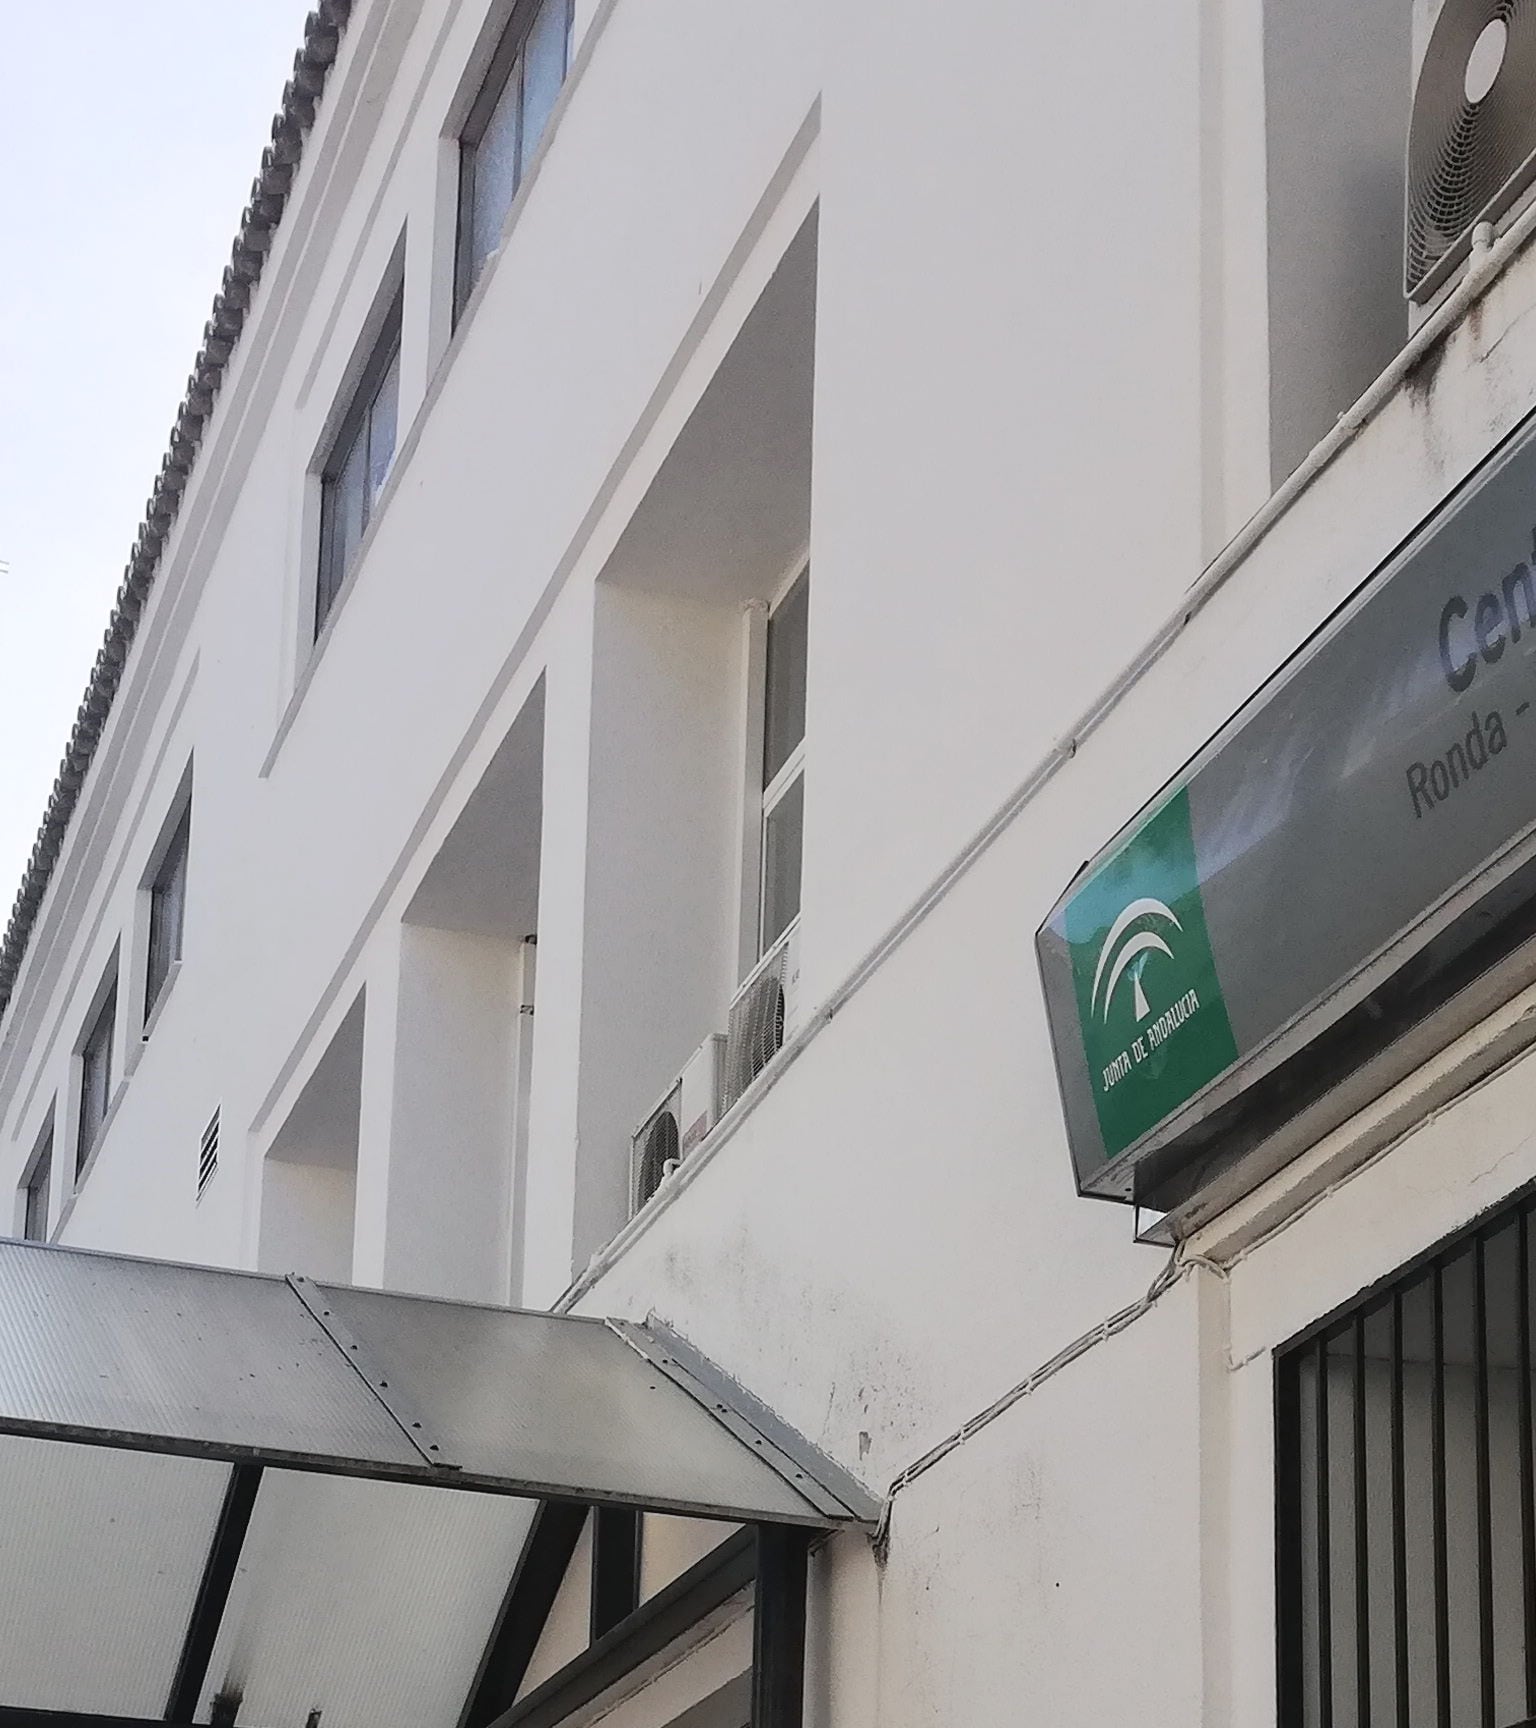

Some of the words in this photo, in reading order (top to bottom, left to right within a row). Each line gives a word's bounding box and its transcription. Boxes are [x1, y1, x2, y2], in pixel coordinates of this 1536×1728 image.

[1405, 710, 1508, 819] Ronda
[1515, 701, 1530, 716] -
[1102, 1050, 1133, 1092] JUNTA
[1131, 1035, 1149, 1064] DE
[1146, 988, 1200, 1051] ANDALUCIA
